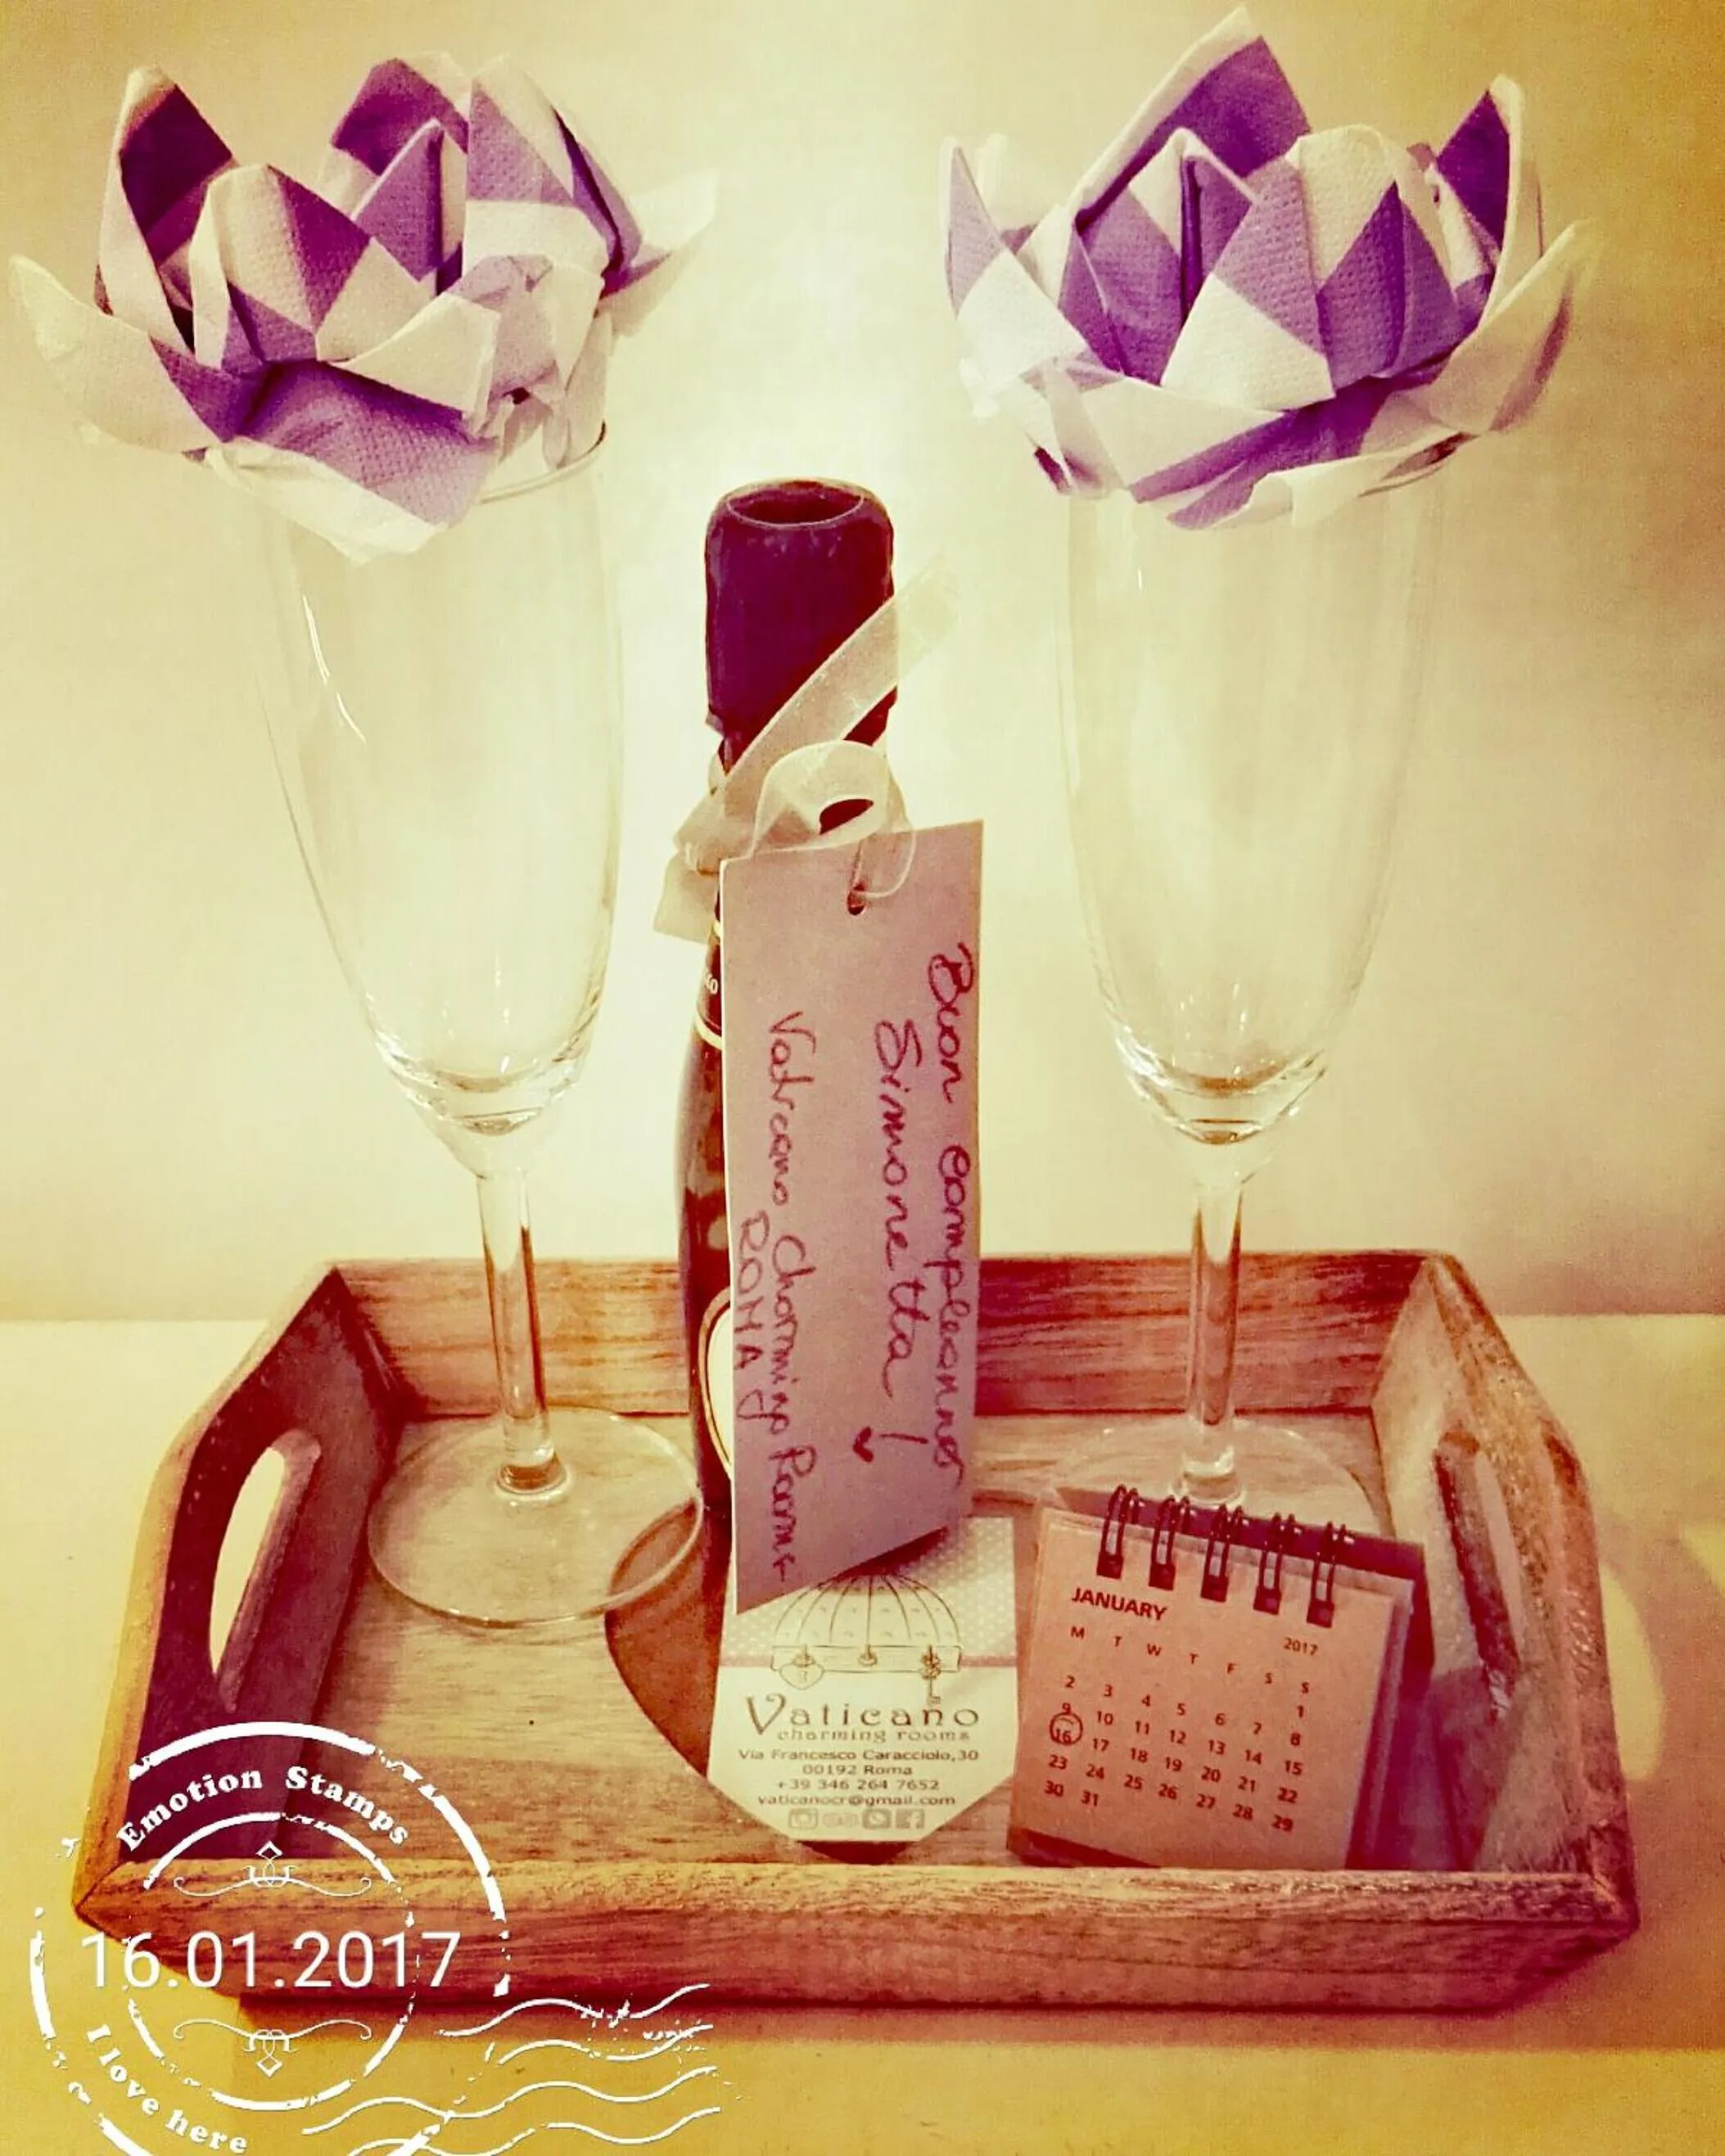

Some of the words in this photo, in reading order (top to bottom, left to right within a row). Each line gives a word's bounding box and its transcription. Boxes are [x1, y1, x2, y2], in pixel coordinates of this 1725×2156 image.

[928, 943, 973, 1104] Buon
[770, 1012, 816, 1206] Vaticano
[735, 1212, 768, 1369] ROMA
[925, 1147, 972, 1487] compleanno
[1071, 1587, 1167, 1621] JANUARY
[1070, 1626, 1085, 1639] M
[1113, 1635, 1123, 1647] T
[1146, 1644, 1162, 1657] W
[1190, 1653, 1198, 1665] T
[1226, 1662, 1234, 1674] F
[1265, 1672, 1272, 1685] S
[1301, 1681, 1309, 1694] S
[1283, 1637, 1318, 1656] 2017
[746, 1693, 979, 1734] Vaticano
[1065, 1676, 1075, 1689] 2
[1104, 1685, 1113, 1698] 3
[1141, 1694, 1151, 1707] 4
[1177, 1703, 1185, 1716] 5
[1214, 1712, 1226, 1726] 6
[1253, 1721, 1262, 1735] 7
[1290, 1733, 1301, 1747] 8
[1298, 1705, 1304, 1718] 1
[738, 1749, 765, 1760] Via
[771, 1749, 857, 1761] Francesco
[862, 1749, 979, 1762] Caracciolo,30
[778, 1728, 887, 1743] charming
[896, 1730, 970, 1742] rooms
[1062, 1702, 1072, 1716] 9
[1097, 1711, 1114, 1726] 10
[1136, 1721, 1150, 1735] 11
[1170, 1730, 1186, 1745] 12
[1208, 1739, 1226, 1756] 13
[1245, 1749, 1262, 1766] 14
[1285, 1760, 1303, 1776] 15
[778, 1779, 811, 1790] +39
[818, 1779, 850, 1790] 346
[857, 1779, 888, 1790] 264
[898, 1779, 940, 1791] 7652
[802, 1764, 857, 1775] 00192
[863, 1764, 913, 1776] Roma
[1053, 1728, 1072, 1744] 16
[1093, 1738, 1109, 1752] 17
[1131, 1748, 1149, 1763] 18
[1165, 1757, 1183, 1772] 19
[1201, 1766, 1221, 1783] 20
[1238, 1775, 1256, 1793] 21
[1277, 1787, 1298, 1804] 22
[758, 1795, 956, 1807] vaticanocr@gmail.com
[1045, 1780, 1064, 1797] 30
[1082, 1790, 1099, 1806] 31
[1048, 1754, 1068, 1770] 23
[1086, 1764, 1105, 1780] 24
[1124, 1774, 1143, 1791] 25
[1158, 1784, 1177, 1800] 26
[1196, 1793, 1216, 1810] 27
[1232, 1803, 1253, 1821] 28
[1271, 1815, 1294, 1832] 29
